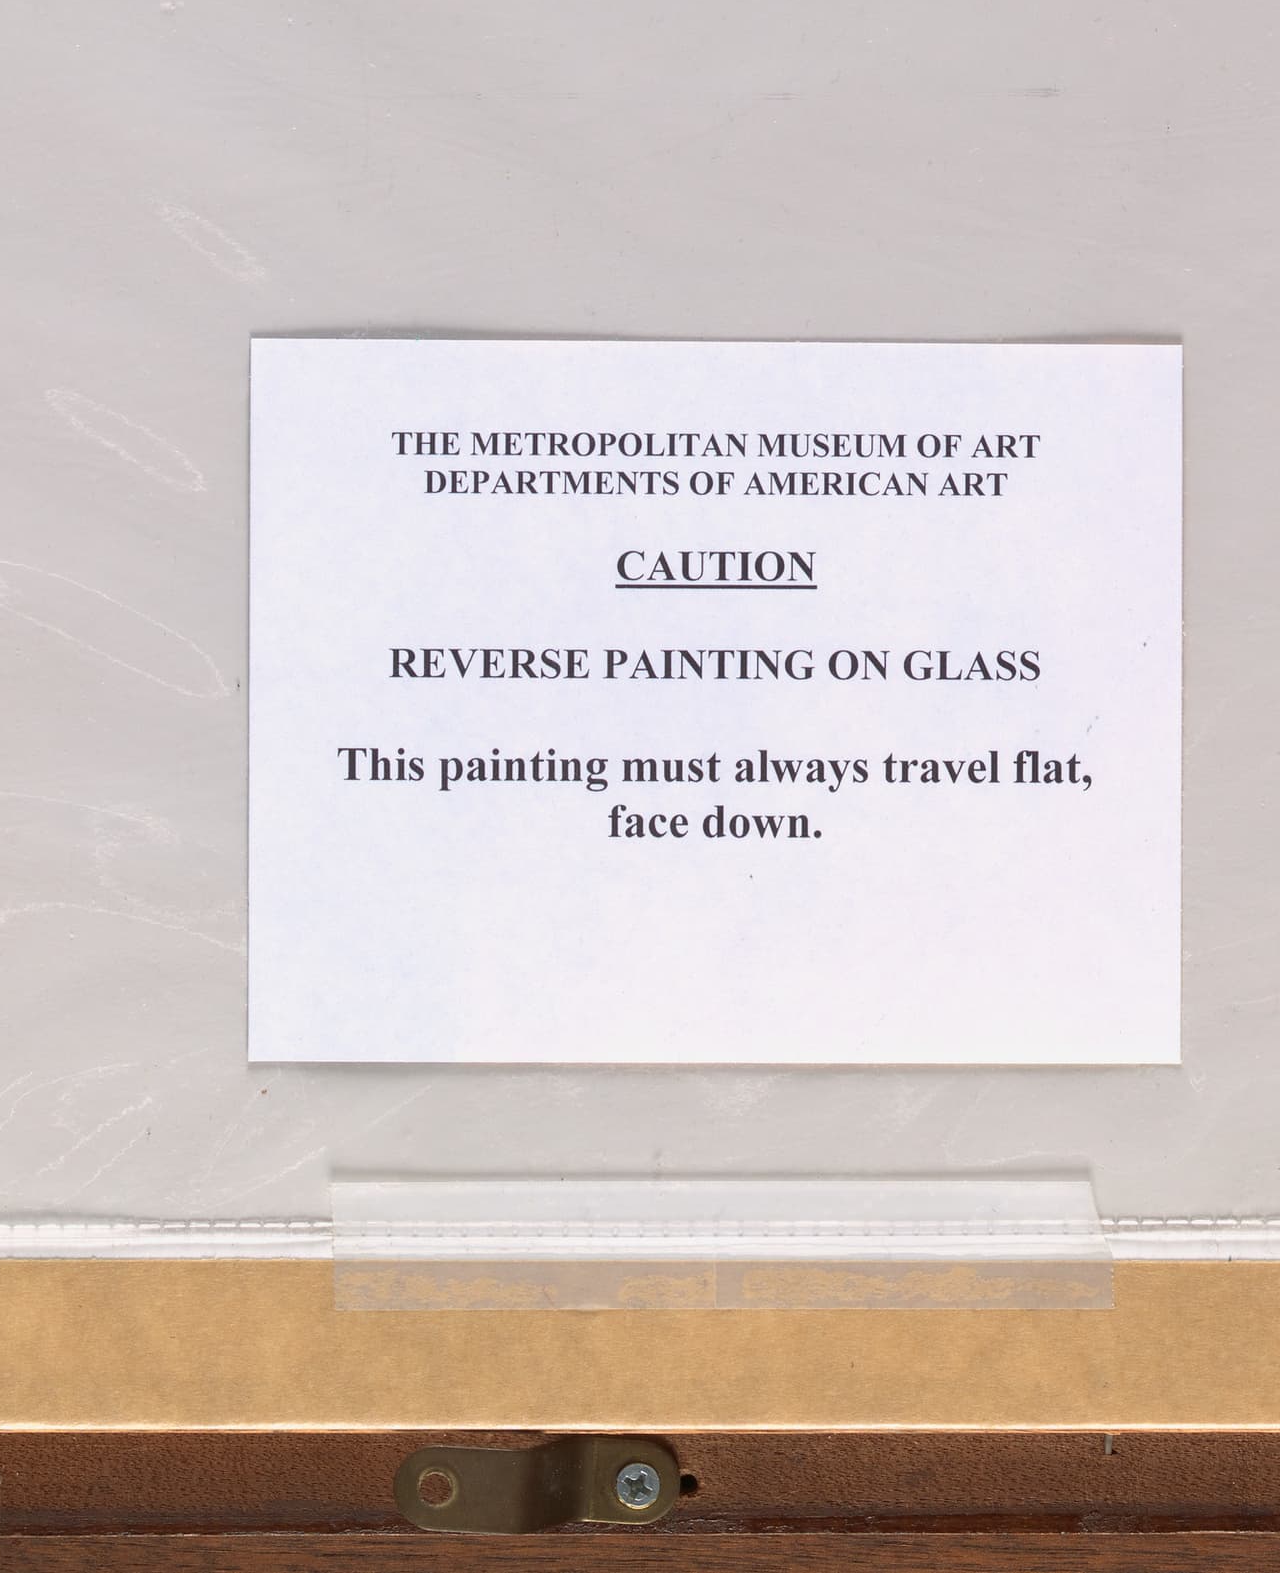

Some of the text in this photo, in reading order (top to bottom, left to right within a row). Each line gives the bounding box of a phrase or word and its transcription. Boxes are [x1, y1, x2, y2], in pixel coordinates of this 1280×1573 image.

[391, 431, 1041, 459] THE METROPOLITAN MUSEUM OF ART
[423, 470, 1009, 497] DEPARTMENTS OF AMERICAN ART
[616, 550, 817, 582] CAUTION
[389, 648, 1041, 682] REVERSE PAINTING ON GLASS
[337, 747, 1093, 793] This painting must always travel flat,
[607, 804, 822, 839] face down.
